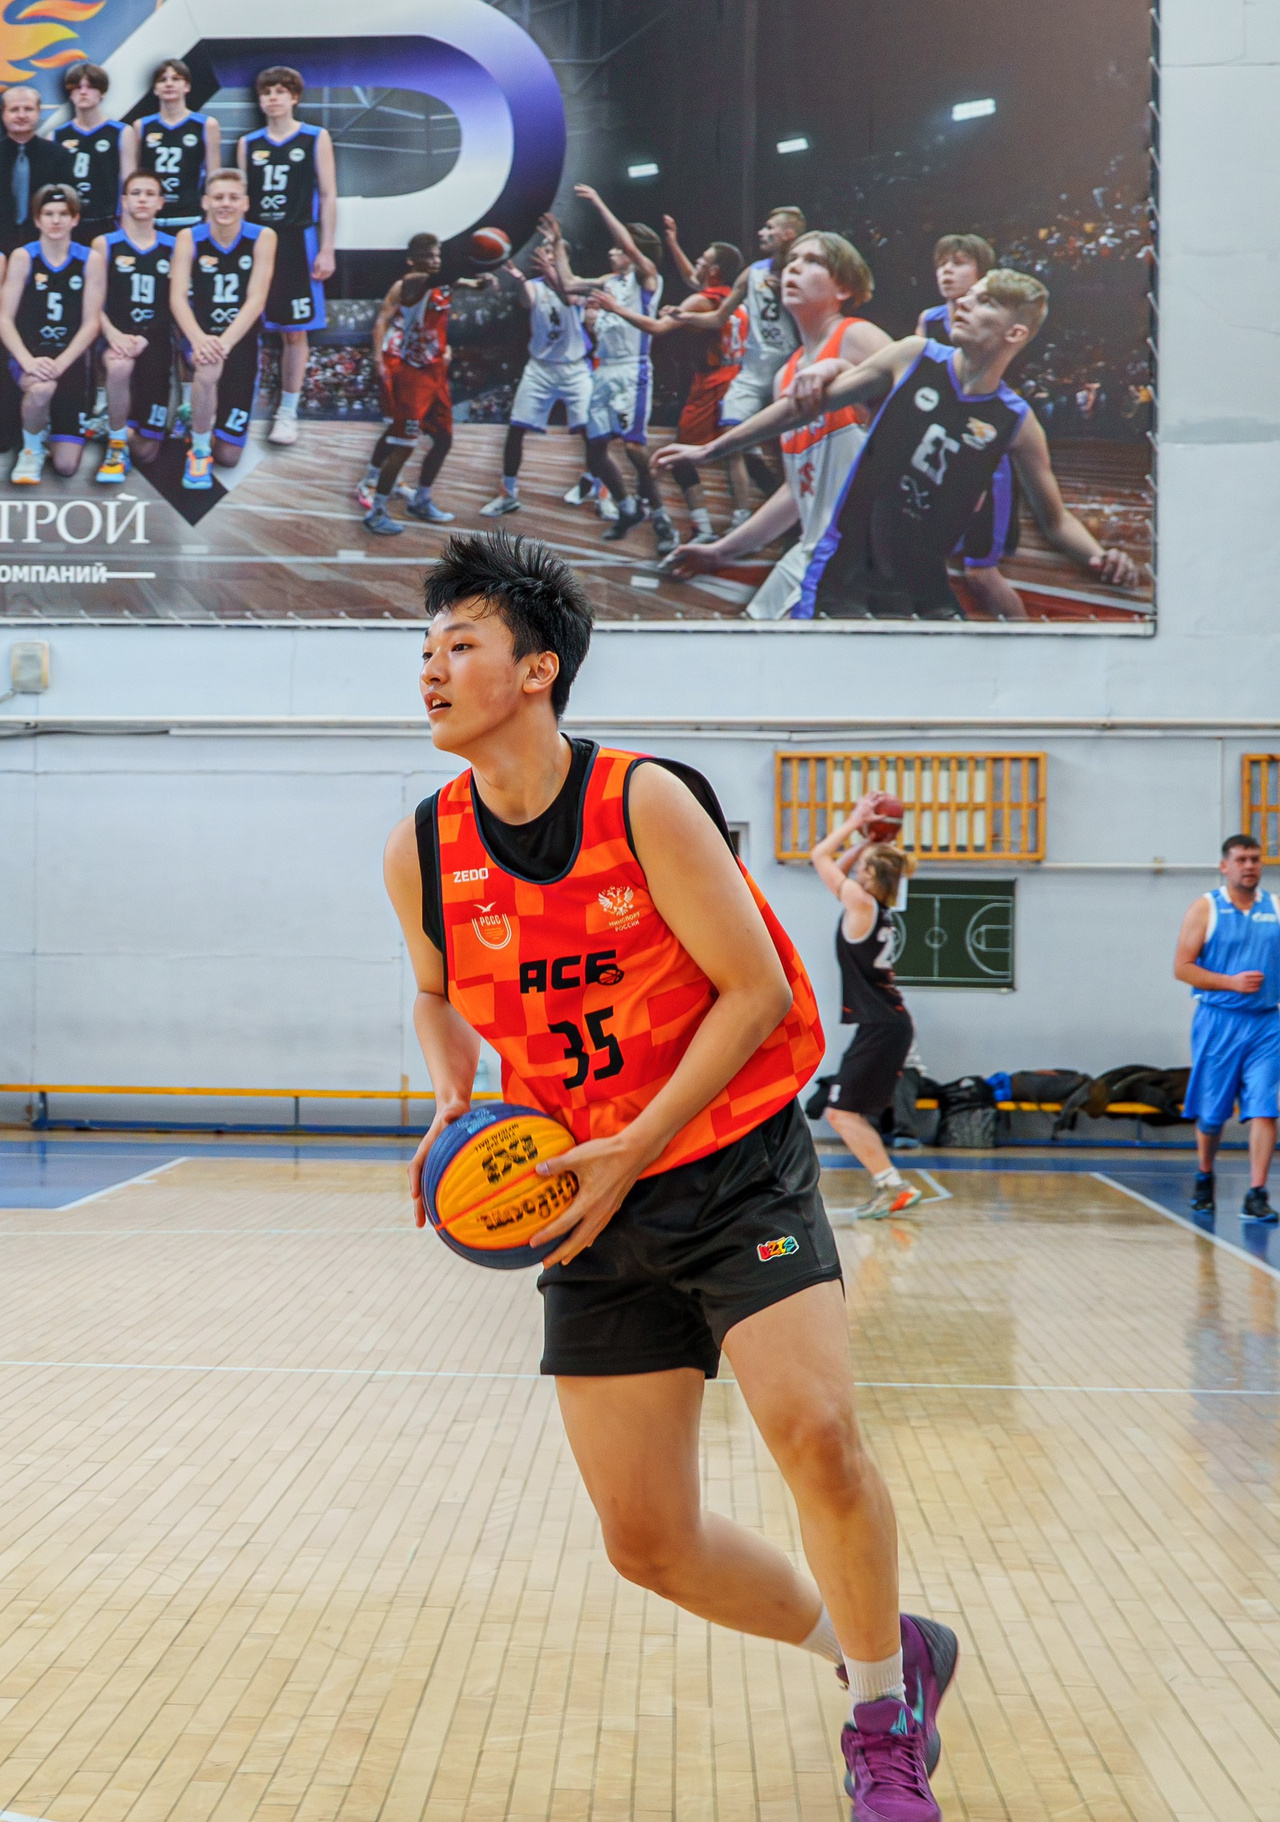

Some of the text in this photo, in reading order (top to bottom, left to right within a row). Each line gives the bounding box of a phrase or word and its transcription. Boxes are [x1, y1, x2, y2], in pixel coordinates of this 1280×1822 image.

[73, 152, 90, 178] 8
[155, 147, 183, 173] 22
[262, 164, 290, 191] 15
[130, 273, 155, 304] 19
[213, 273, 240, 304] 12
[46, 292, 63, 321] 5
[291, 298, 311, 320] 15
[225, 408, 249, 432] 12
[453, 867, 489, 883] ZEDO
[547, 1005, 625, 1091] 35
